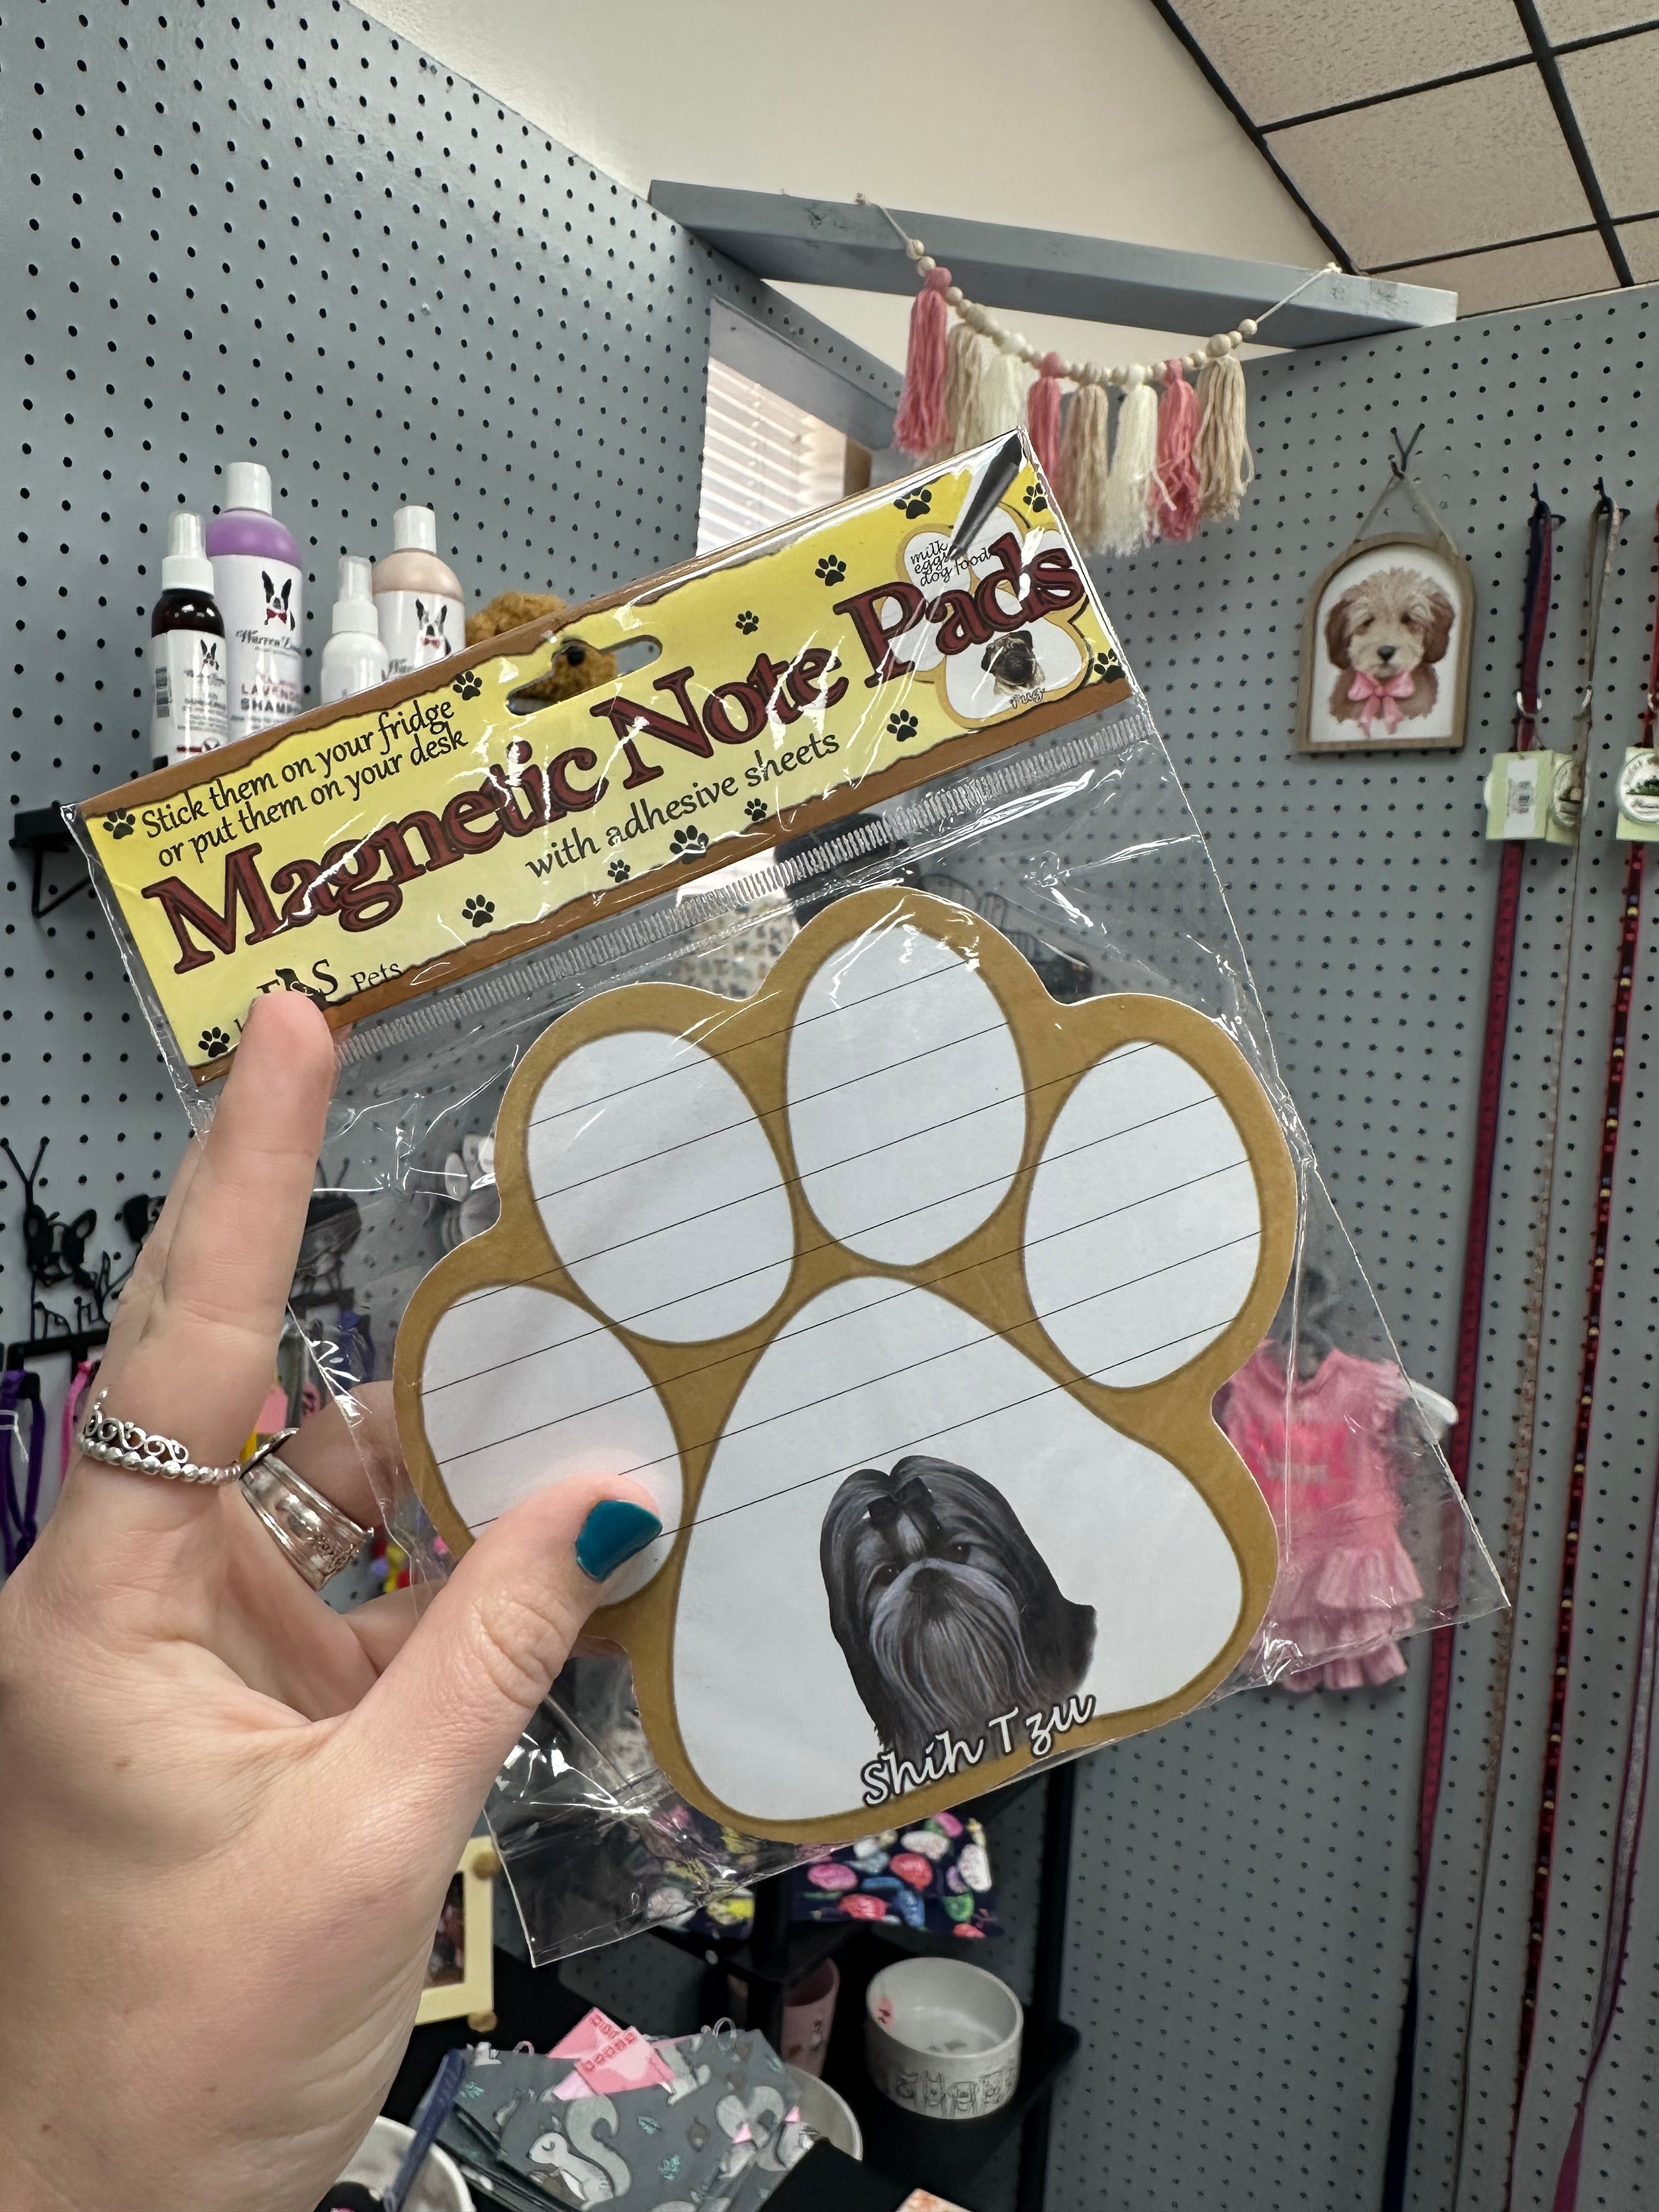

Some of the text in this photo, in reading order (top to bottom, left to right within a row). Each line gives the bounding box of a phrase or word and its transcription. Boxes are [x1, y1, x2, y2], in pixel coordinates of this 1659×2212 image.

[910, 540, 948, 565] milk
[914, 551, 951, 574] eggs
[920, 547, 993, 586] dog food
[141, 532, 1085, 974] Magnetic Note Pads
[142, 699, 455, 838] Stick them on your fridge
[159, 721, 469, 867] or put them on your desk
[525, 733, 840, 878] with adhesive sheets
[349, 962, 403, 992] Pets
[860, 1694, 1097, 1807] Shih Tzu
